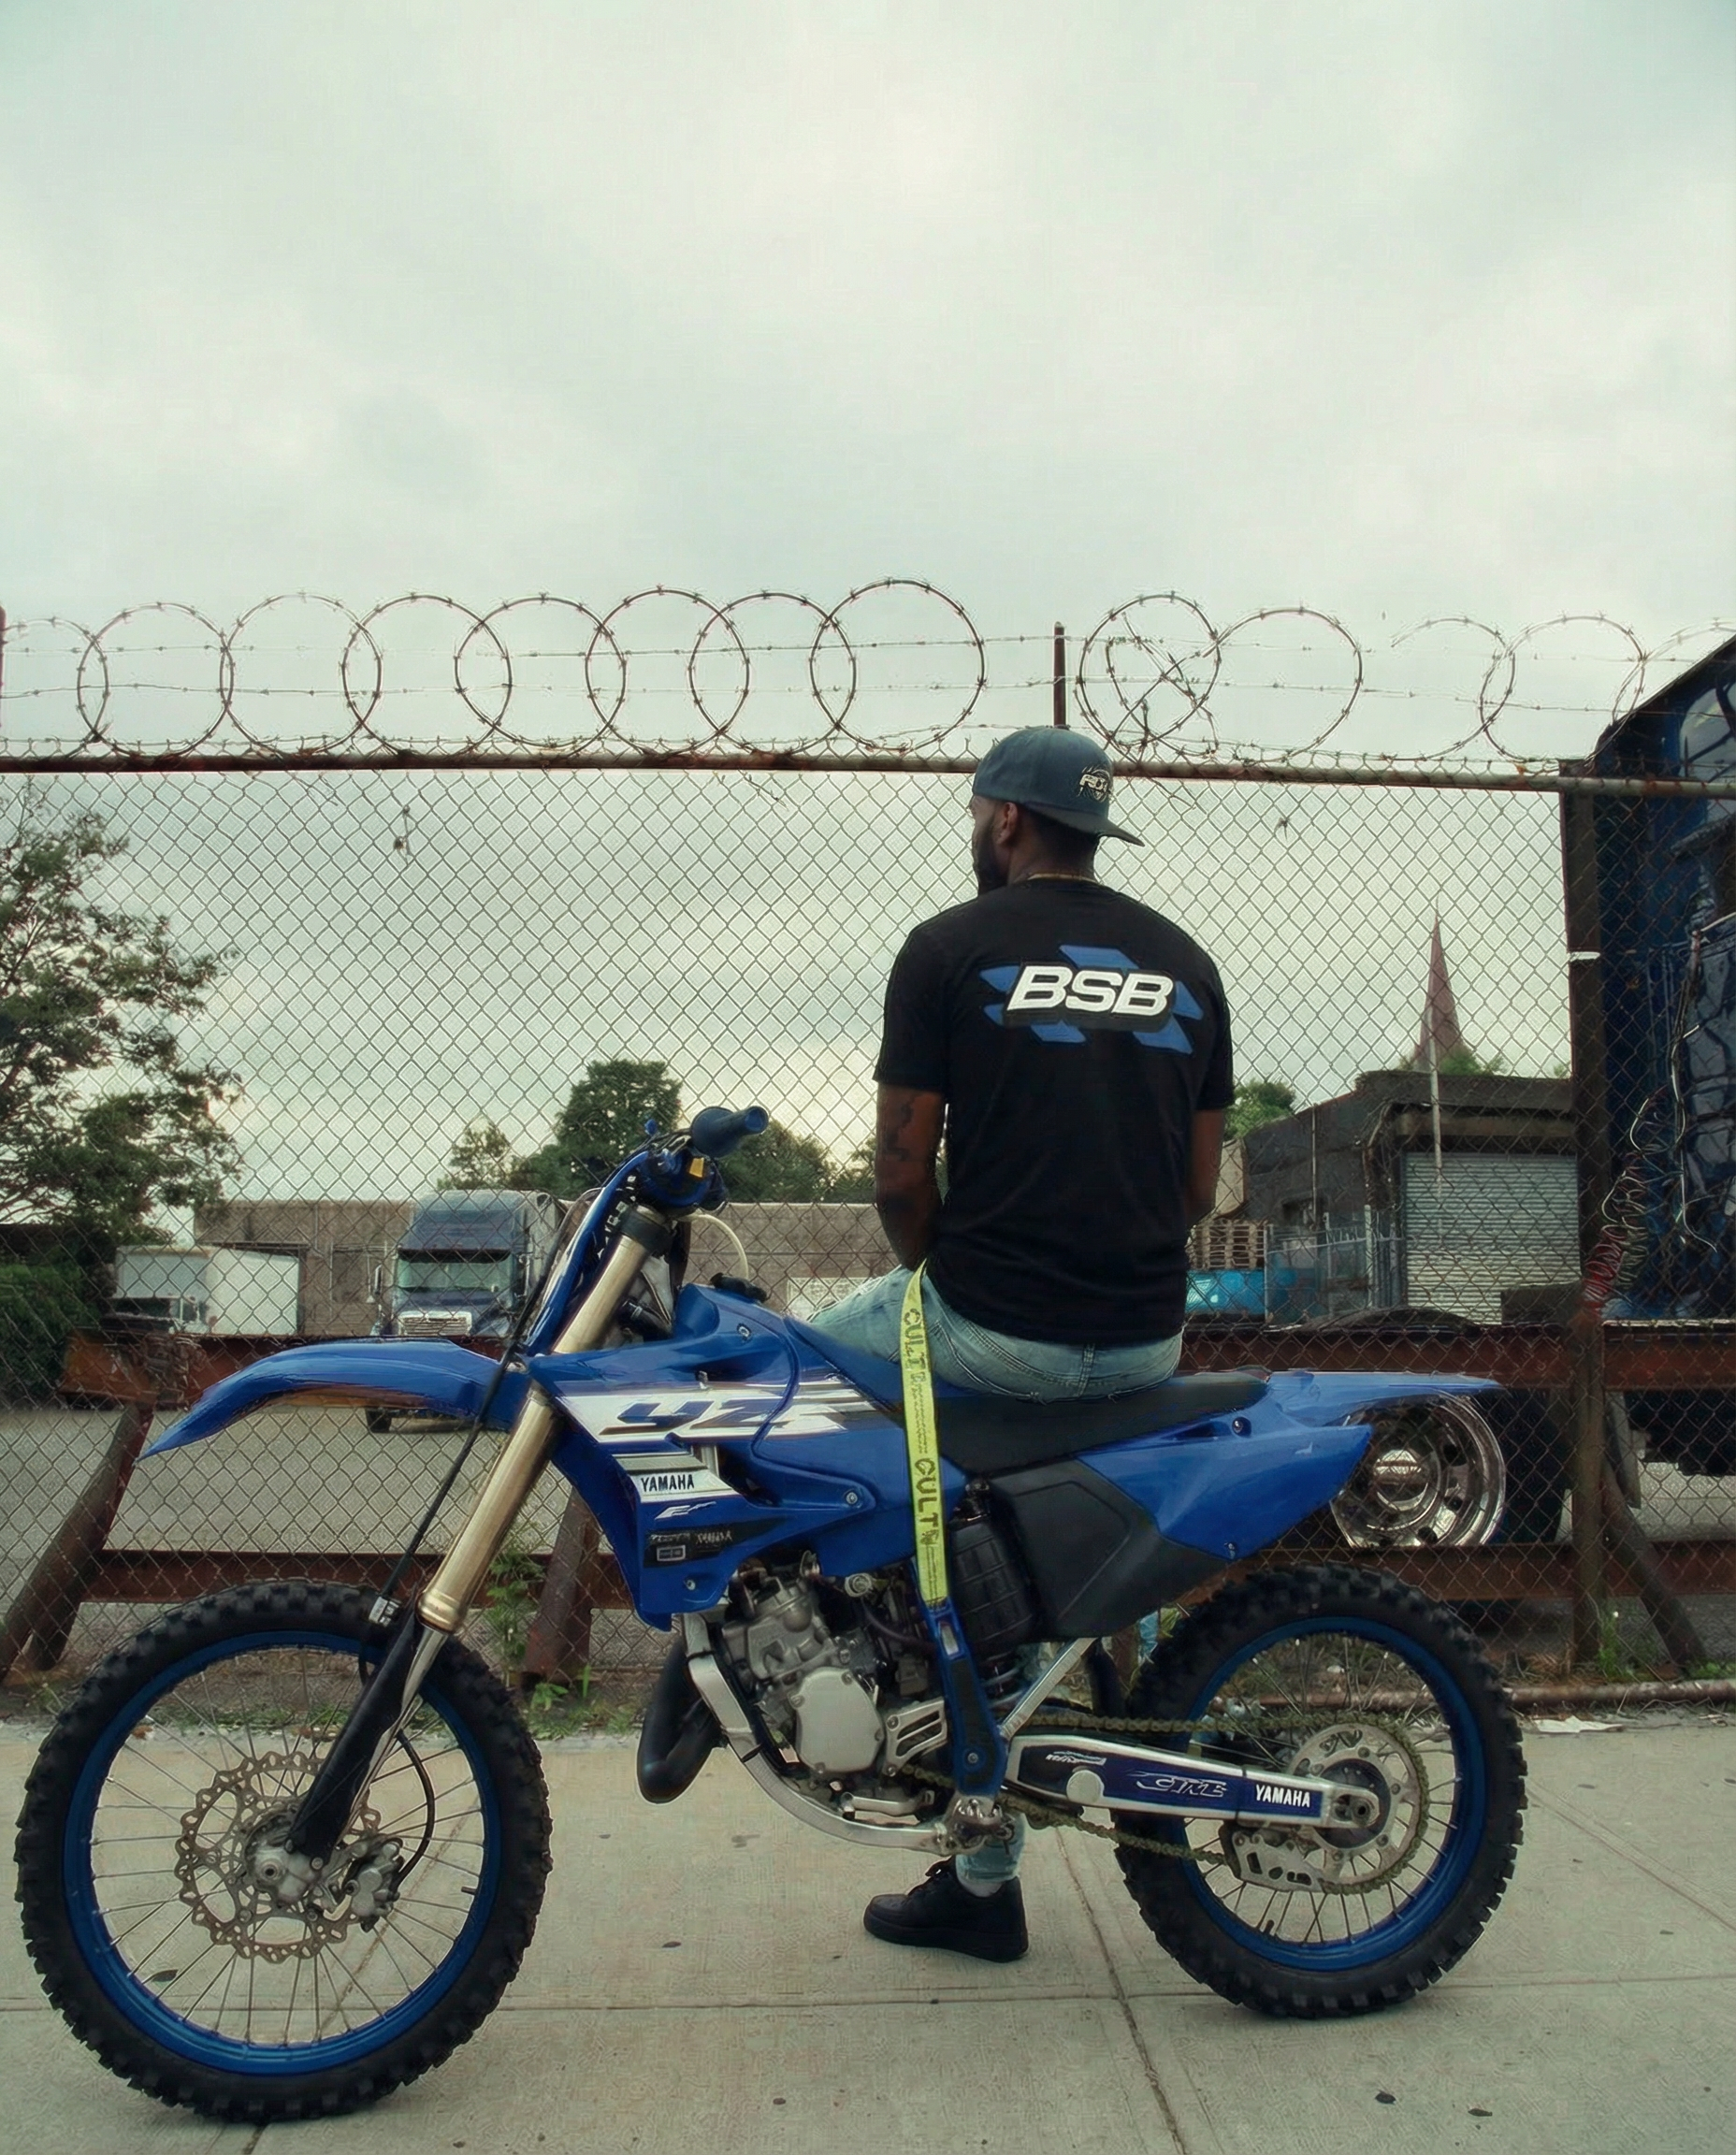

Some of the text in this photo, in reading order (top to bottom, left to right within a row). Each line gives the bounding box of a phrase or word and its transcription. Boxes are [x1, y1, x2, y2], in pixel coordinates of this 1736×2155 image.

[1006, 965, 1174, 1017] BSB
[641, 1474, 695, 1492] YAMAHA
[915, 1458, 938, 1527] CULT
[1255, 1784, 1310, 1808] YAMAHA
